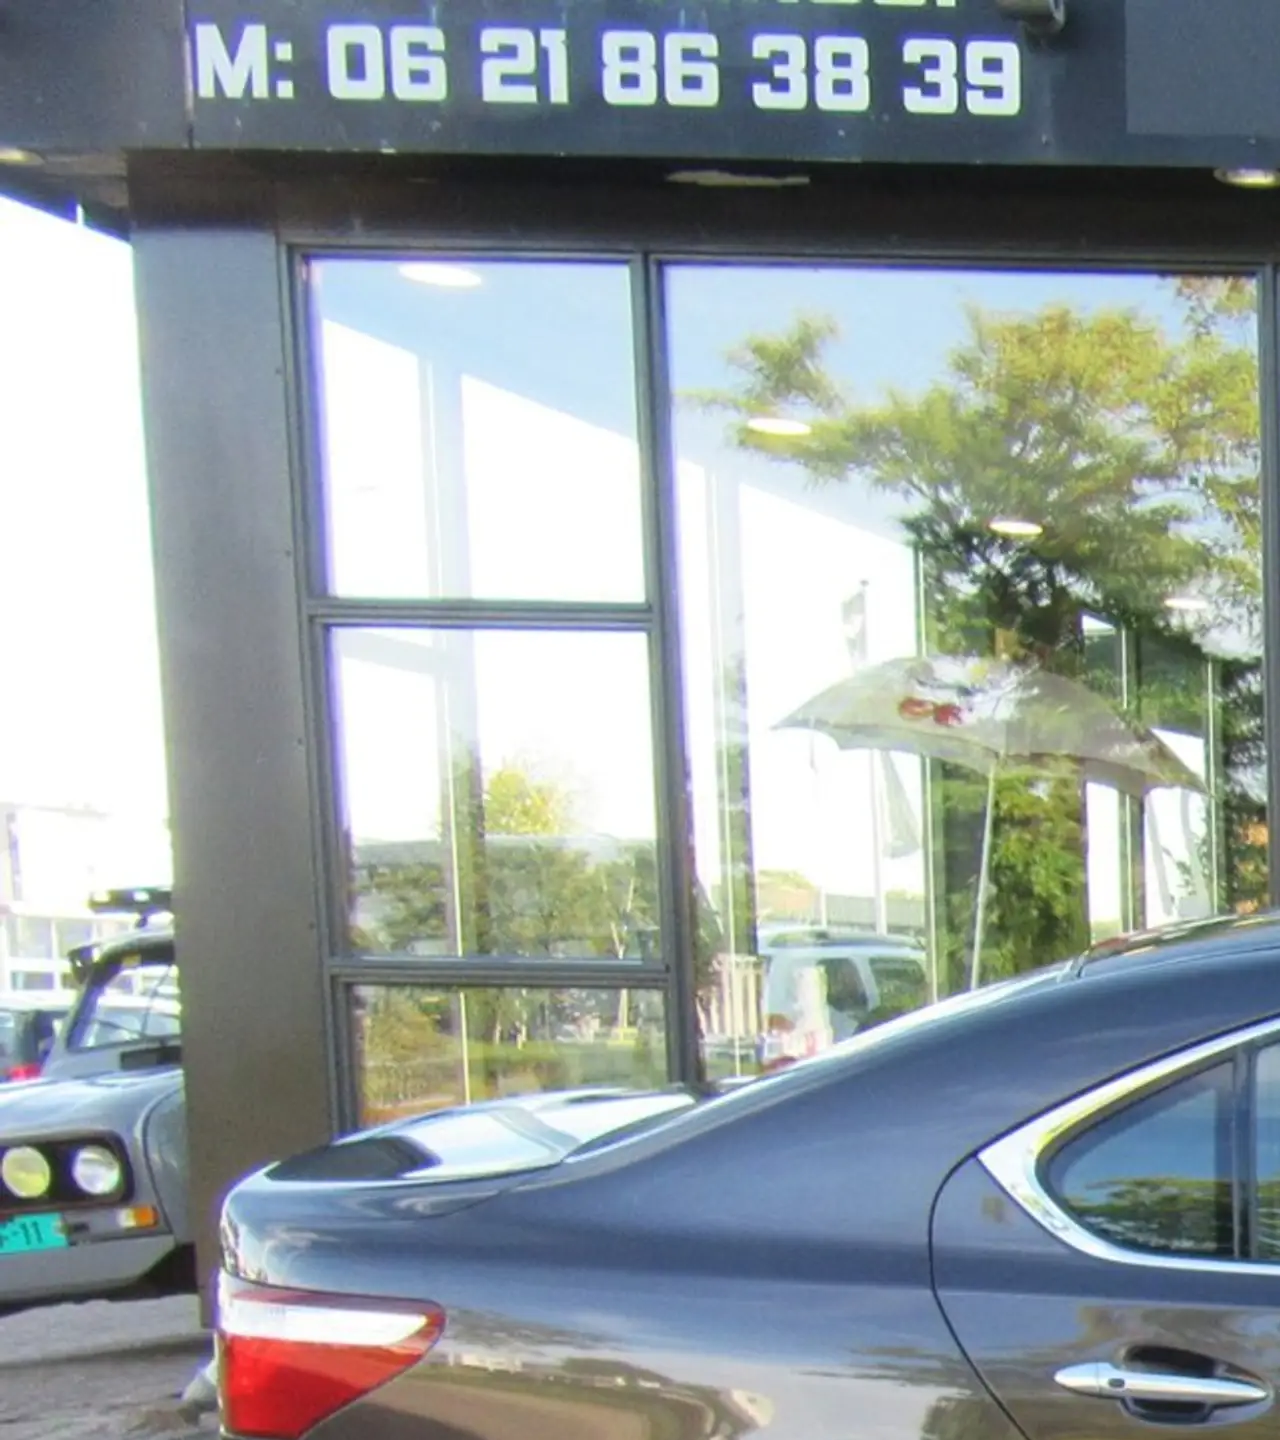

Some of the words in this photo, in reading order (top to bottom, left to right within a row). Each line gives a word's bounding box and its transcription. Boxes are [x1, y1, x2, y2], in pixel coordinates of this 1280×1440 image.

[195, 23, 294, 99] M:
[327, 24, 448, 100] 06
[480, 27, 570, 104] 21
[602, 30, 720, 107] 86
[752, 34, 870, 112] 38
[903, 38, 1021, 116] 39
